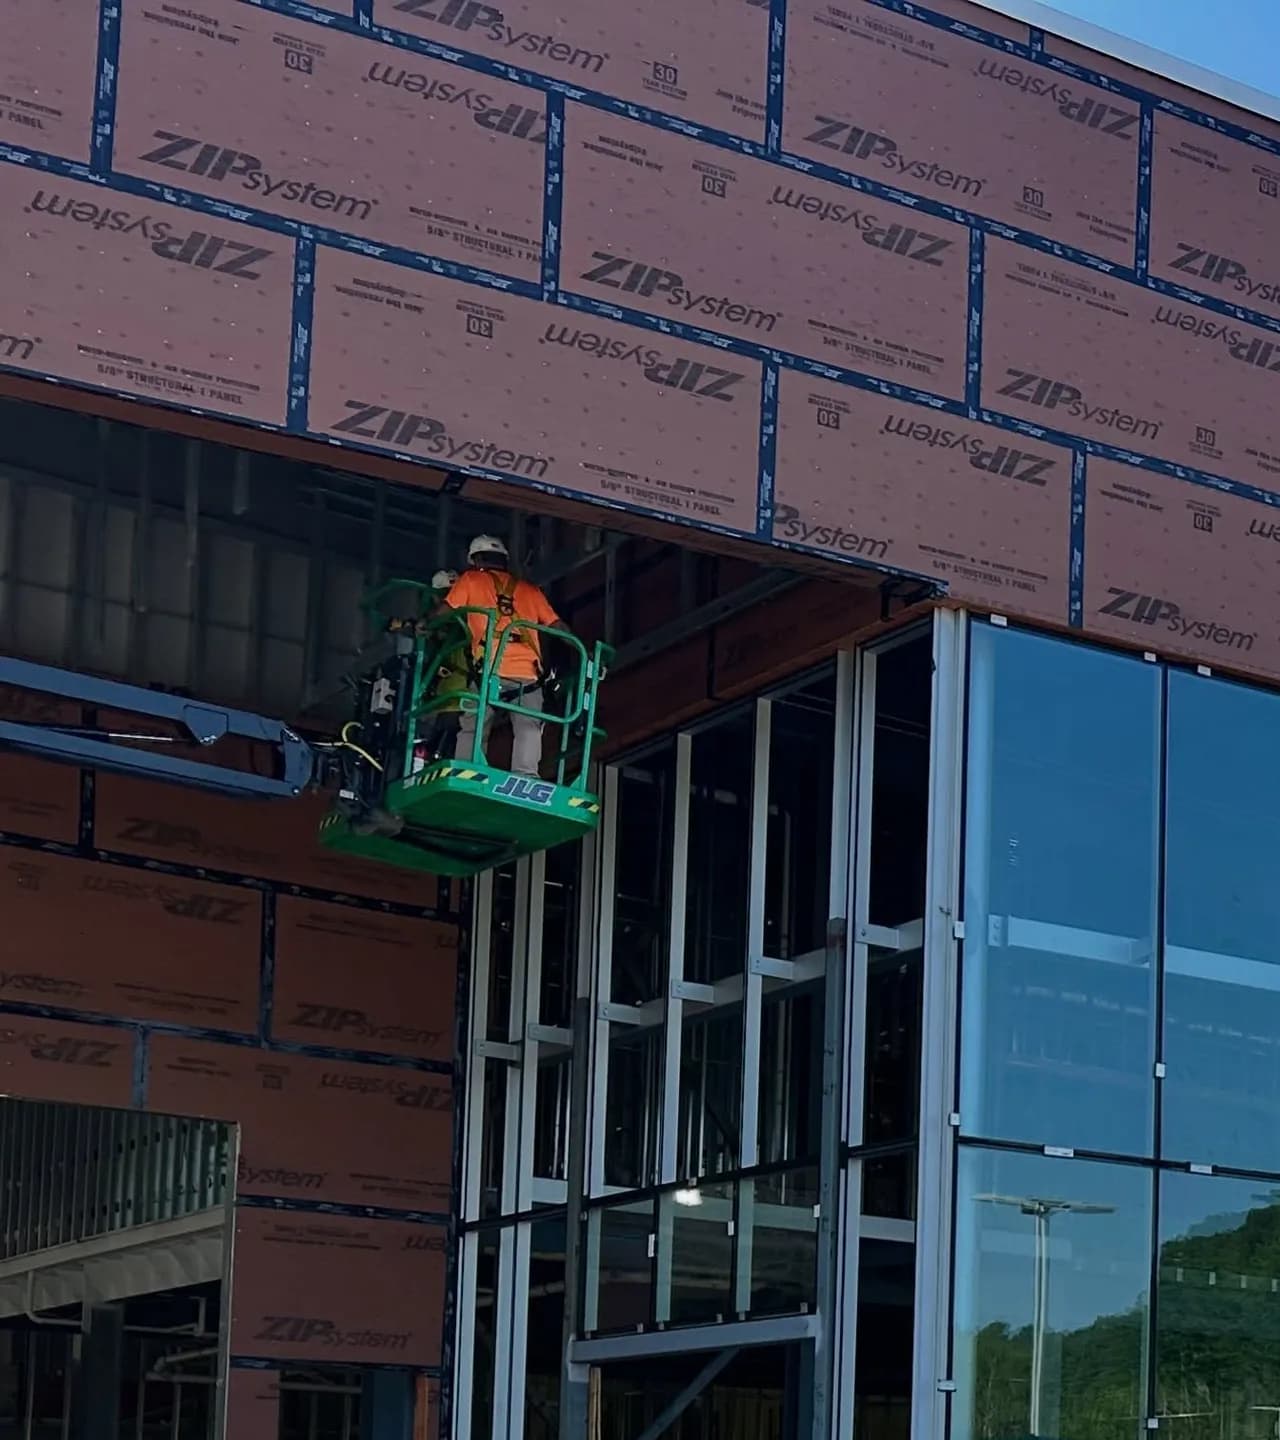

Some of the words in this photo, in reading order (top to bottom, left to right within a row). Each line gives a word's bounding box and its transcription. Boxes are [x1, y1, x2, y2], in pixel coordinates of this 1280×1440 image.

[284, 50, 312, 74] 30
[653, 62, 677, 85] 30
[362, 62, 546, 144] IPsystem
[702, 176, 727, 198] 30
[467, 314, 493, 338] 30
[773, 503, 894, 558] Psystem
[492, 775, 557, 806] JLG
